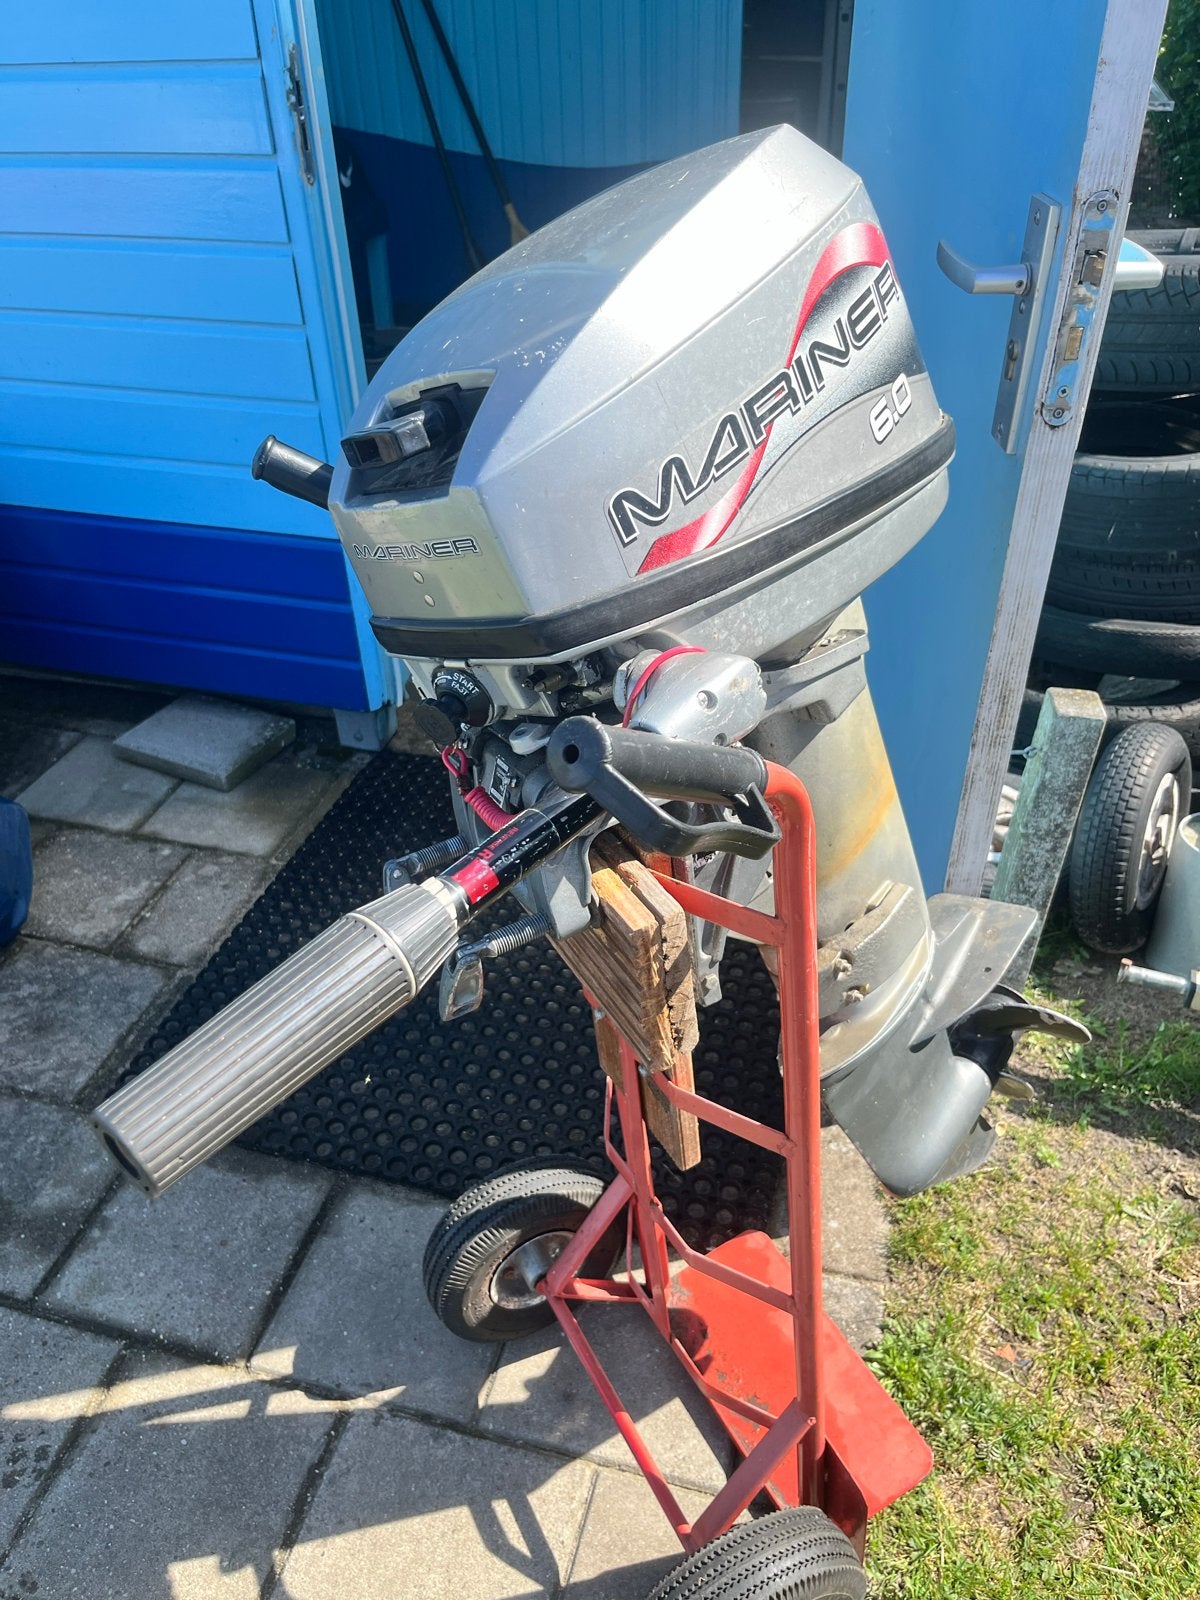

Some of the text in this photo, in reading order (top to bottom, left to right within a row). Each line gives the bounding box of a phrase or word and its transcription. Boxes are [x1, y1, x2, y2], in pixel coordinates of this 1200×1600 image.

[608, 260, 900, 548] MARINER
[869, 373, 911, 442] 6.0
[352, 537, 481, 561] MARINER
[451, 680, 470, 696] FAST
[453, 672, 480, 694] START
